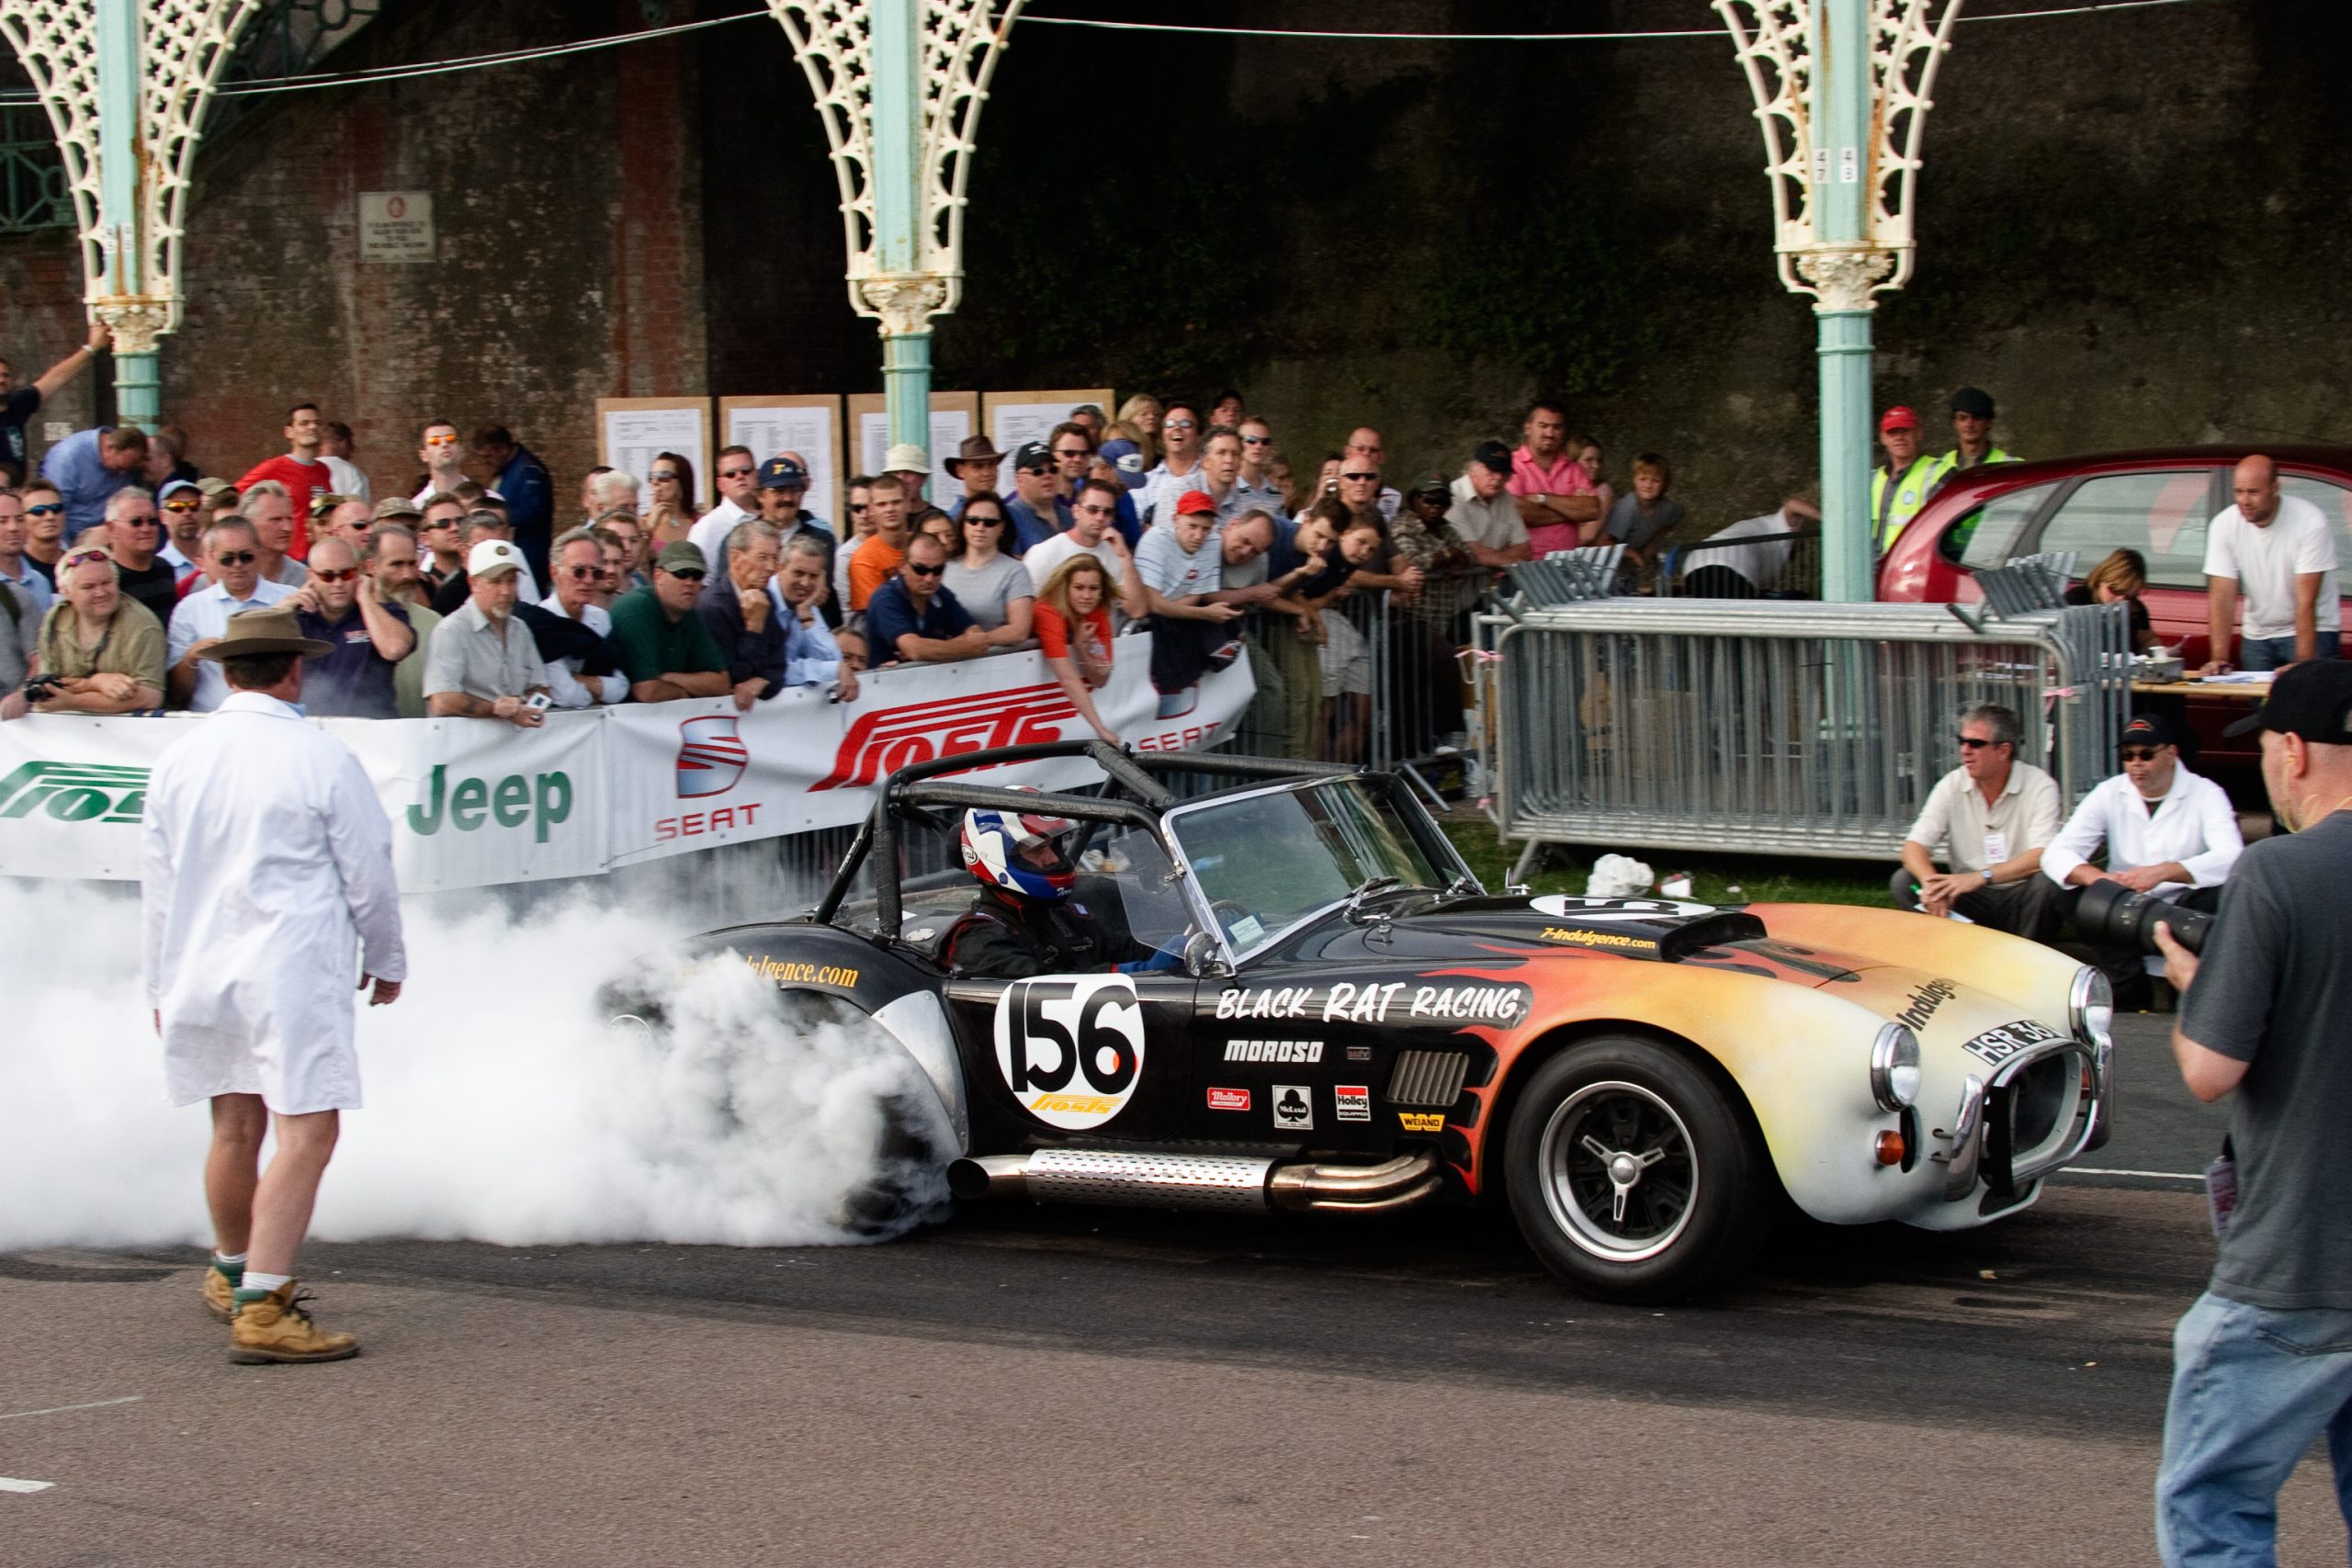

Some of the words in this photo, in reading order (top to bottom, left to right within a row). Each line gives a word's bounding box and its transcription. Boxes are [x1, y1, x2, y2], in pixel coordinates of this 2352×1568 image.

[1138, 721, 1222, 751] SEAT
[407, 763, 572, 843] Jeep
[654, 803, 762, 842] SEAT
[1216, 987, 1314, 1020] BLACK
[1322, 982, 1407, 1022] RAT
[1409, 986, 1521, 1019] RACING
[1009, 982, 1138, 1095] 156
[1224, 1040, 1324, 1063] MOROSO
[1963, 1029, 2030, 1066] HSR
[1029, 1093, 1125, 1114] Frosts
[1212, 1090, 1248, 1103] Mallory
[1338, 1096, 1368, 1109] Holley
[1404, 1117, 1440, 1127] WEIAND
